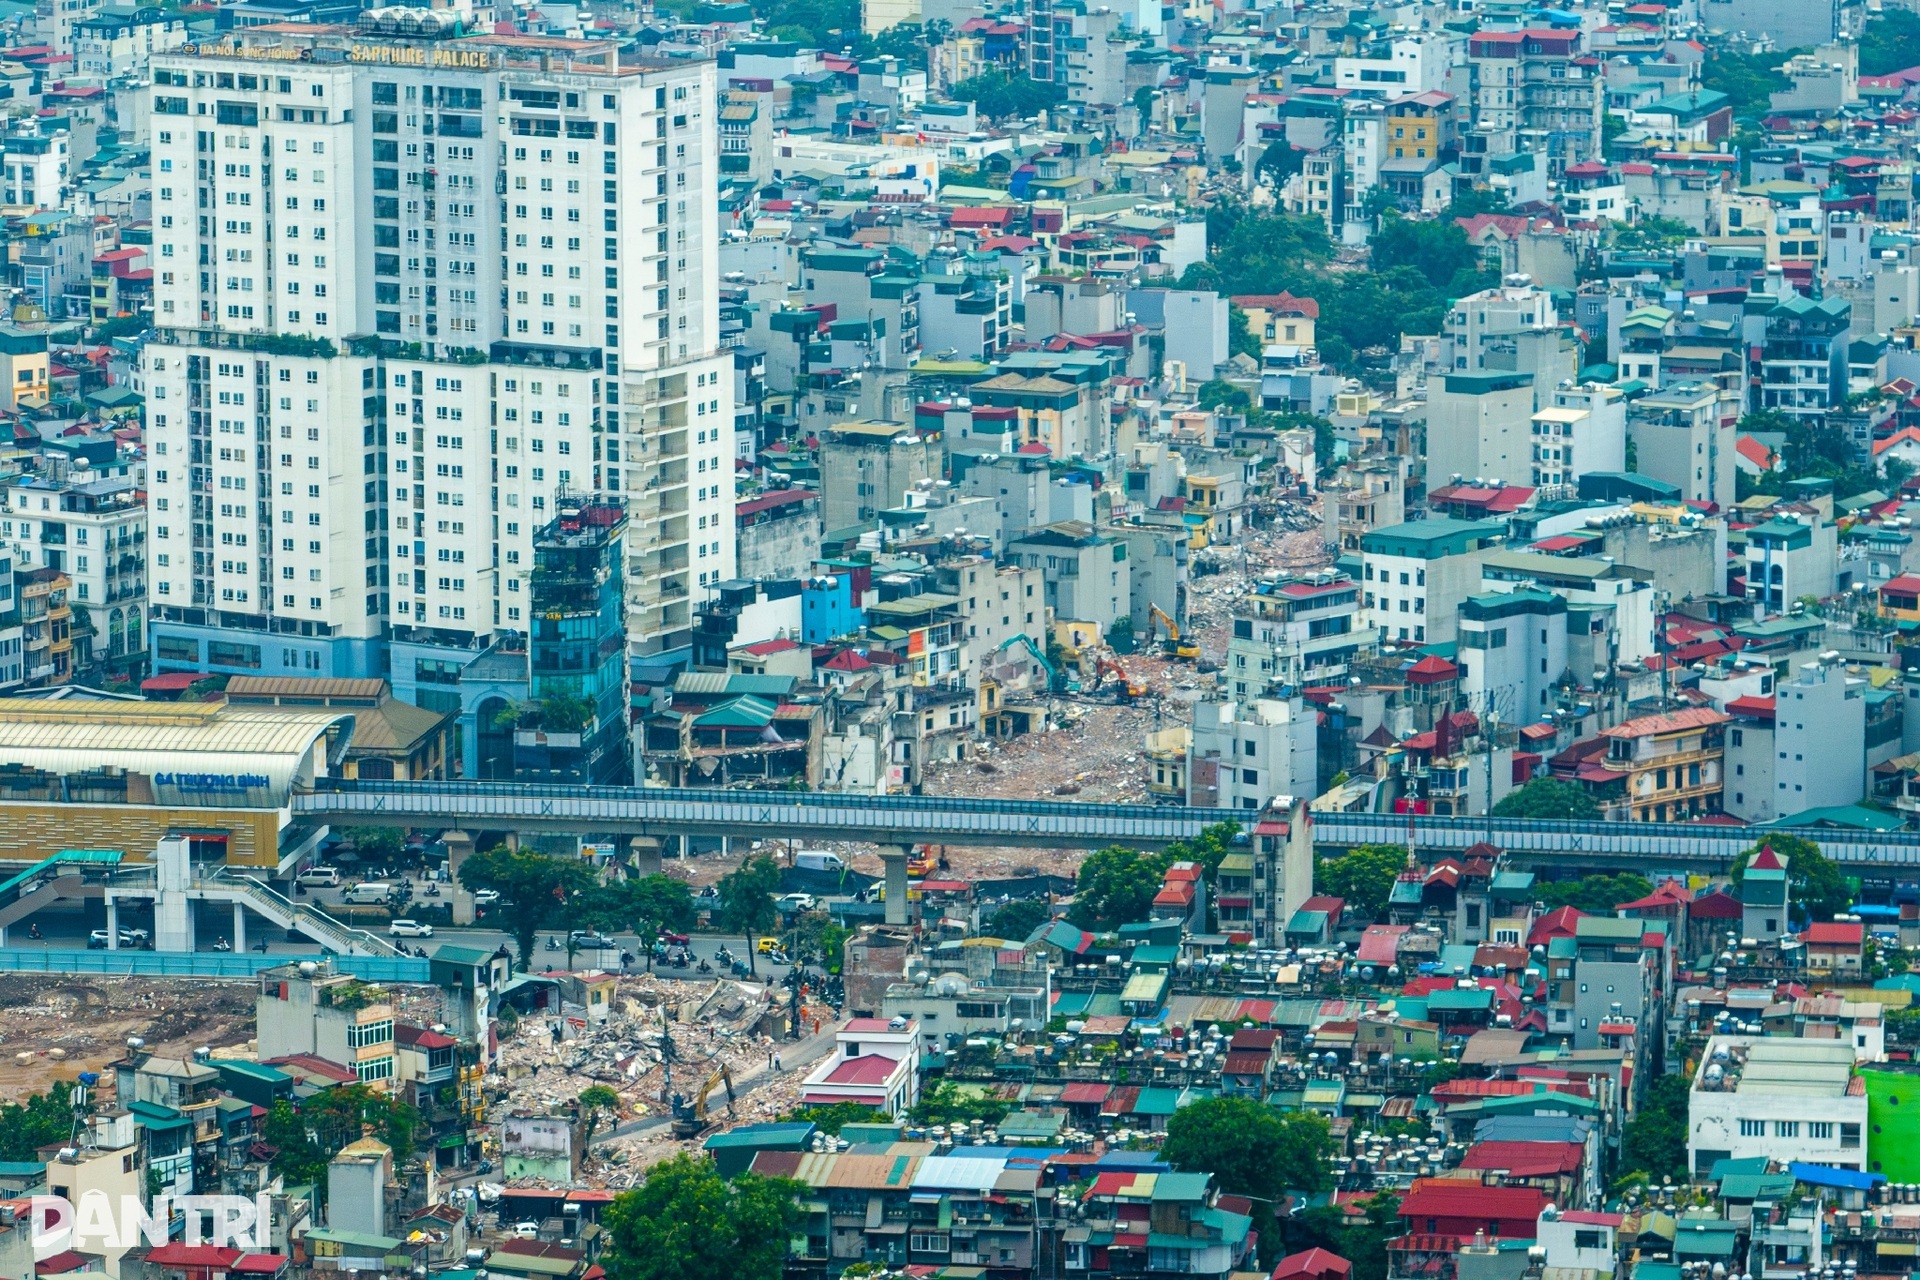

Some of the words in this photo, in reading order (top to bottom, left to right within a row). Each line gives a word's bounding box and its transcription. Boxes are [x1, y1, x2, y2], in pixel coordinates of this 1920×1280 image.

[352, 44, 424, 64] SAPPHIRE
[433, 50, 487, 68] PALACE
[154, 772, 176, 785] GA
